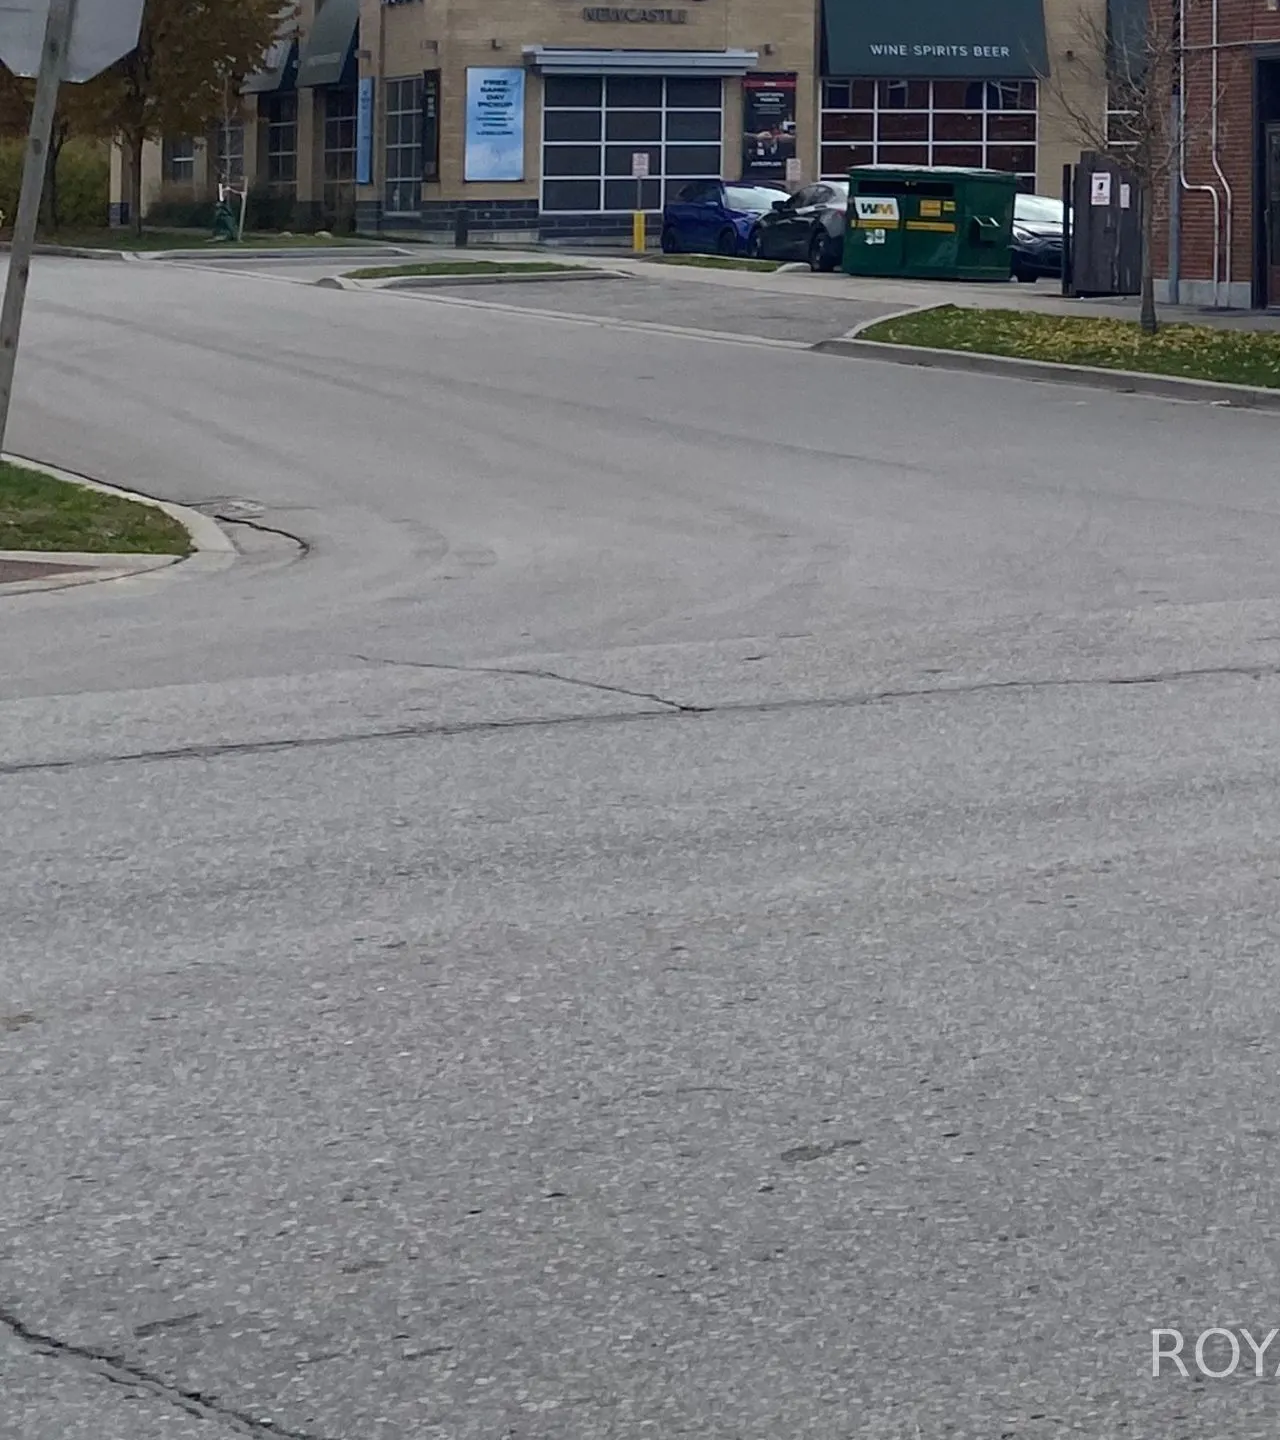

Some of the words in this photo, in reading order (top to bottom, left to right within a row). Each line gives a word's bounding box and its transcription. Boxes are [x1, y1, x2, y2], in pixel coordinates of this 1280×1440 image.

[583, 7, 688, 24] NEWCASTLE
[870, 44, 907, 56] WINE
[913, 45, 968, 57] SPIRITS
[973, 46, 1010, 58] BEER
[861, 203, 894, 215] WM
